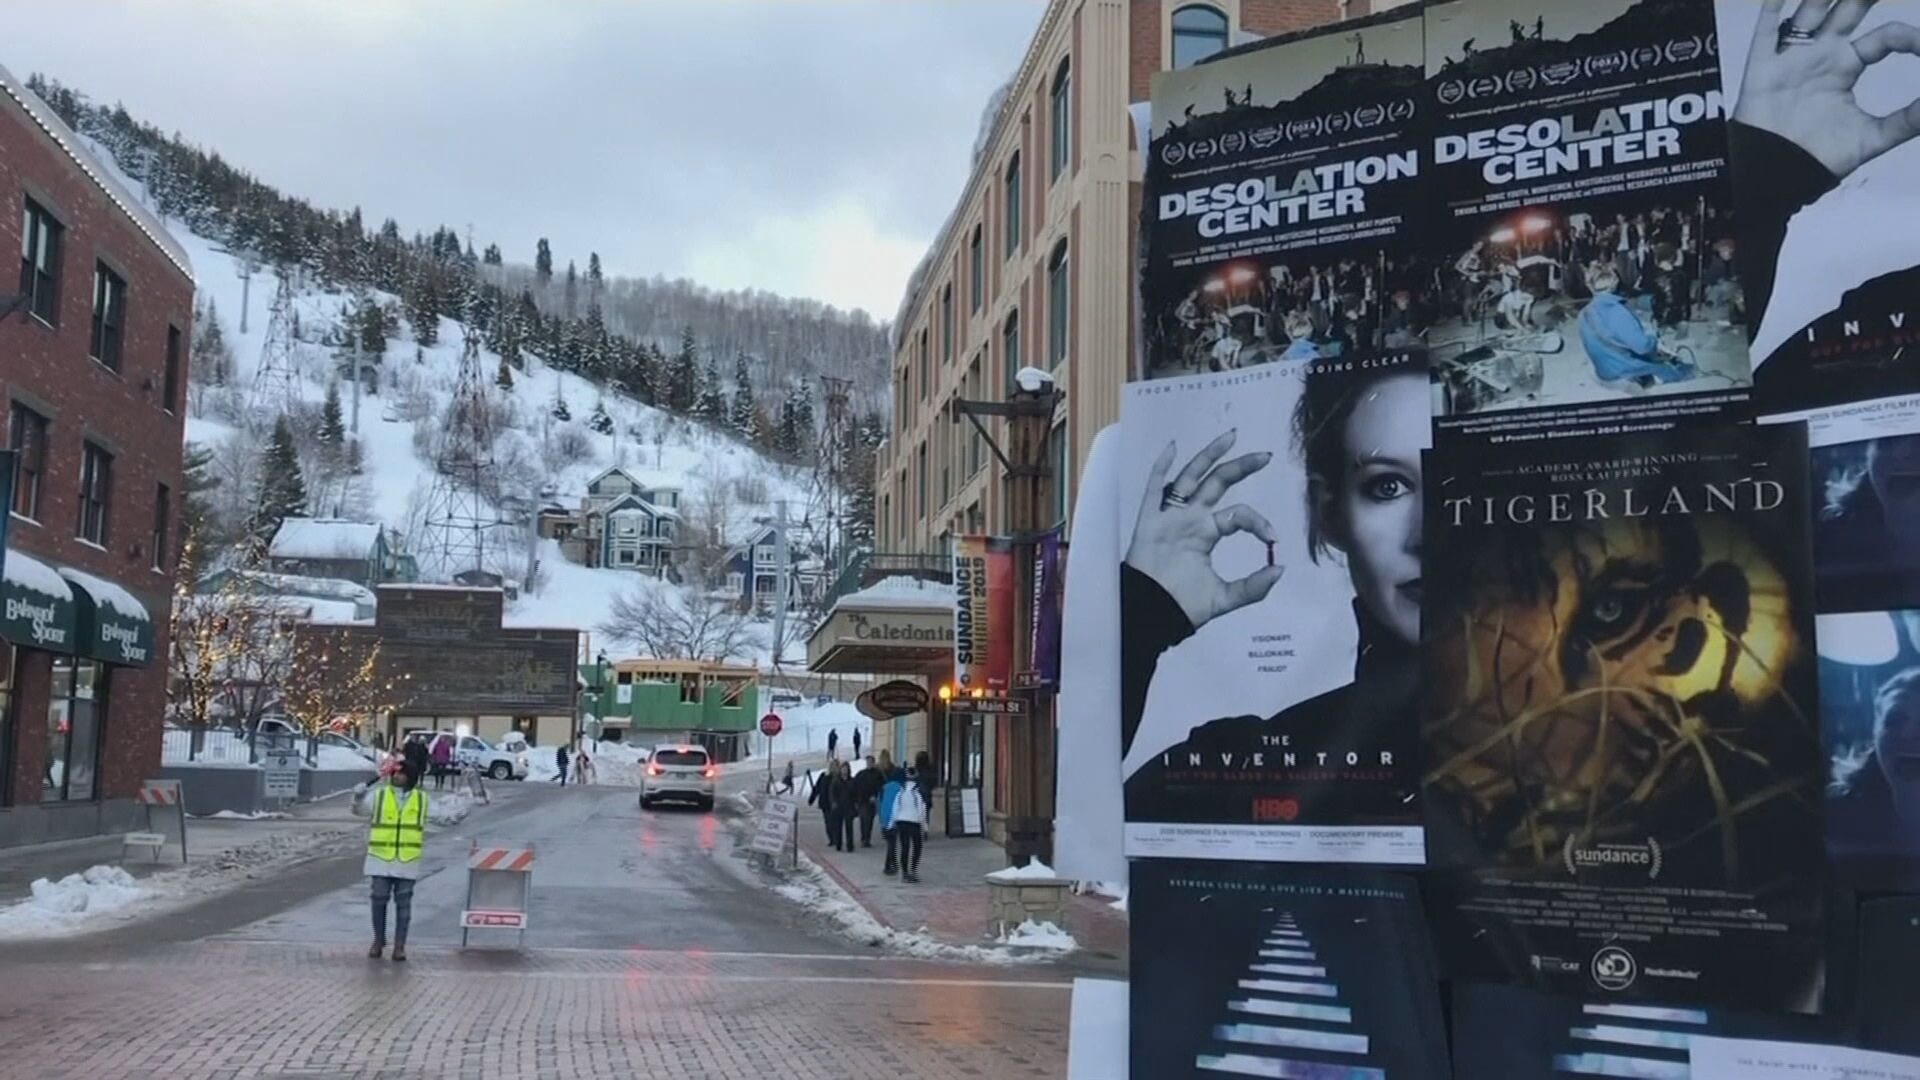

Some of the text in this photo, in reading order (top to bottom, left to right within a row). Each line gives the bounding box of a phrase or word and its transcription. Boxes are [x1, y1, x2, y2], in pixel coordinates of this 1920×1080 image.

[1435, 90, 1725, 164] DESOLATION
[1482, 127, 1681, 184] CENTER
[1158, 150, 1418, 221] DESOLATION
[1198, 187, 1366, 238] CENTER
[1138, 354, 1410, 396] FROM THE DIRECTOR OF GOING CLEAR
[1832, 403, 1881, 418] SUNDANCE
[1884, 400, 1907, 410] FILM
[1516, 463, 1580, 474] ACADEMY
[1444, 480, 1784, 526] TIGERLAND
[974, 557, 986, 597] 2019
[956, 556, 973, 665] SUNDANCE
[976, 700, 1005, 712] Main
[1006, 702, 1020, 712] St
[1262, 736, 1290, 746] THE
[1164, 752, 1393, 766] INVENTOR
[1253, 797, 1299, 821] HBO
[1575, 848, 1649, 864] sundance
[1271, 884, 1296, 893] LOVE
